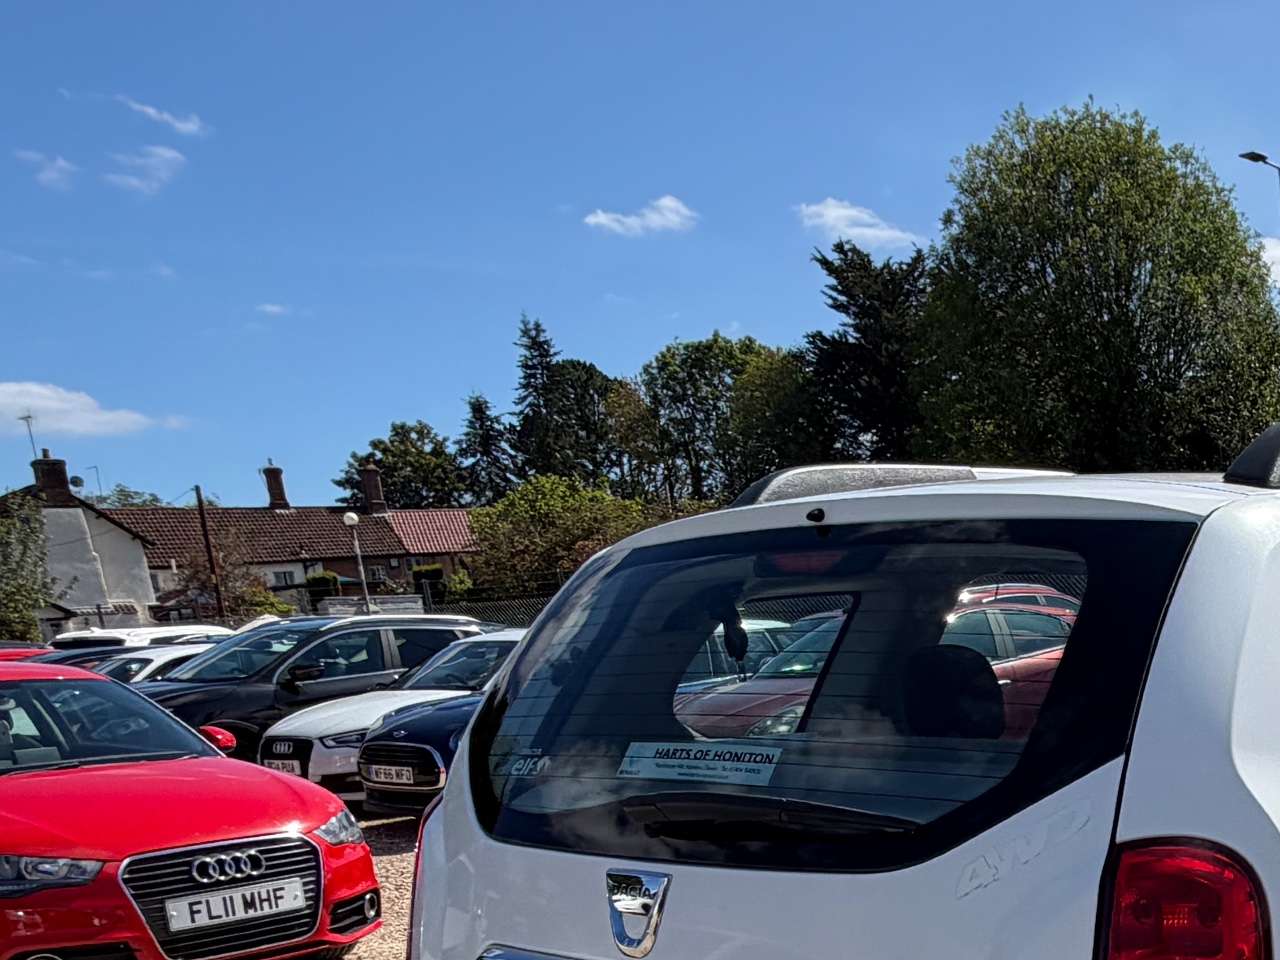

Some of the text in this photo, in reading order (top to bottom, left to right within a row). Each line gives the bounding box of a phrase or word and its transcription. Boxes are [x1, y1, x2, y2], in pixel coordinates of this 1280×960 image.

[655, 748, 775, 765] HARTS OF HONITON
[188, 887, 285, 923] FL11 MHF
